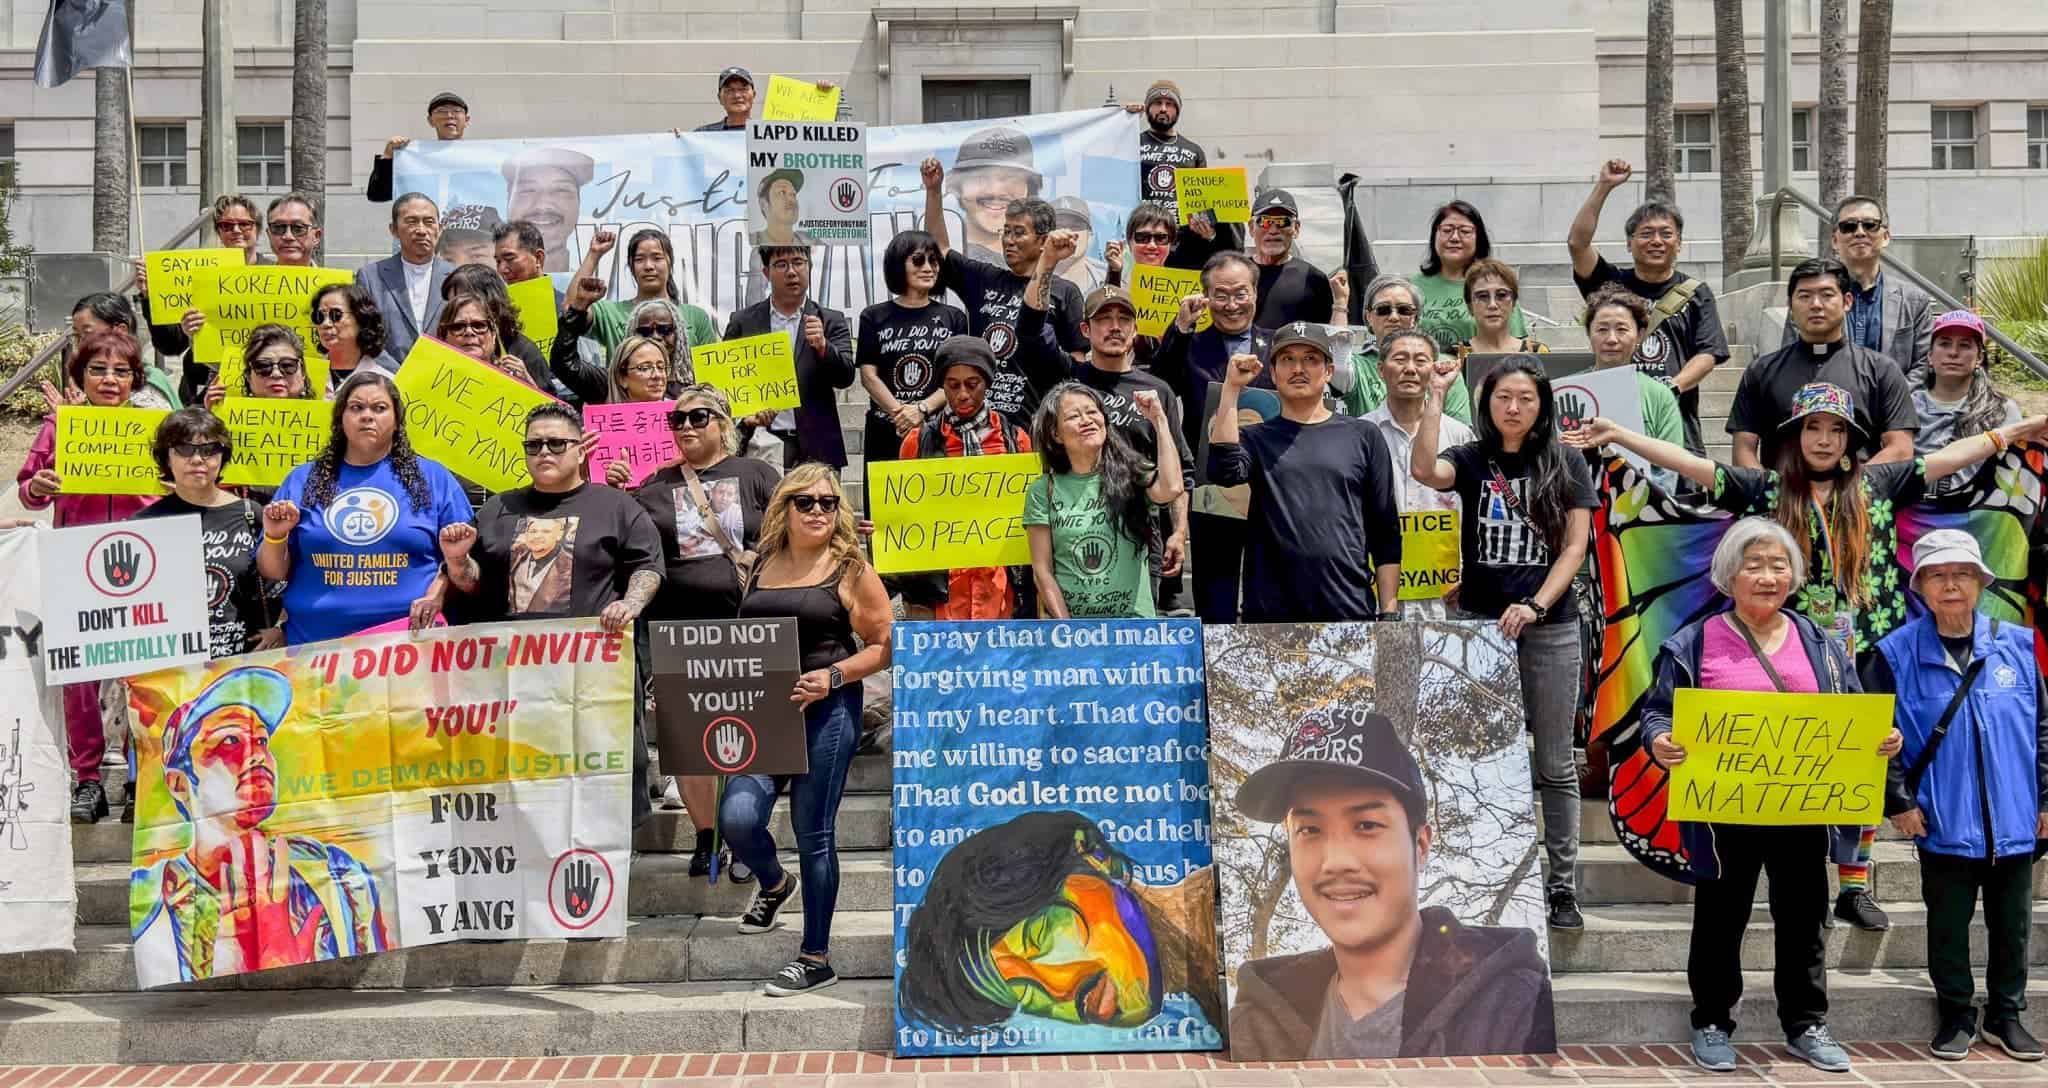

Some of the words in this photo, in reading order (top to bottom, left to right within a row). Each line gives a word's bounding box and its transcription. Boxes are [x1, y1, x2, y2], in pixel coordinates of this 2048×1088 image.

[753, 124, 798, 141] LAPD
[803, 126, 859, 142] KILLED
[750, 152, 778, 167] MY
[784, 153, 864, 169] BROTHER
[1182, 176, 1225, 187] RENDER
[1184, 189, 1203, 198] AID
[1185, 200, 1207, 209] NOT
[160, 257, 192, 273] SAY
[1139, 275, 1202, 294] MENTA
[218, 302, 298, 321] UNITED
[1152, 295, 1182, 306] HEA
[908, 325, 928, 338] DID
[700, 341, 785, 366] JUSTICE
[731, 362, 758, 380] FOR
[431, 362, 484, 410] WE
[724, 384, 752, 405] NG
[754, 377, 797, 402] YANG
[1103, 394, 1127, 409] DID
[229, 407, 321, 429] MENTAL
[230, 431, 320, 451] HEALTH
[404, 391, 466, 448] YONG
[468, 429, 529, 483] YANG
[884, 473, 926, 505] NO
[884, 523, 925, 553] NO
[931, 516, 1026, 553] PEACE
[1400, 515, 1453, 532] TICE
[201, 531, 229, 545] DID
[311, 553, 354, 569] UNITED
[358, 553, 409, 569] FAMILIES
[324, 571, 344, 586] FOR
[346, 571, 398, 586] JUSTICE
[1073, 578, 1110, 586] JYYPC
[78, 607, 129, 633] DON'T
[132, 602, 168, 626] KILL
[683, 625, 722, 646] DID
[730, 624, 781, 645] NOT
[896, 627, 904, 650] I
[912, 632, 980, 656] pray
[987, 627, 1046, 650] that
[1052, 624, 1108, 649] God
[1114, 623, 1196, 647] make
[47, 646, 81, 672] THE
[85, 633, 177, 667] MENTALLY
[182, 632, 208, 655] ILL
[353, 645, 419, 681] DID
[431, 637, 498, 673] NOT
[506, 631, 624, 667] INVITE
[687, 658, 764, 680] INVITE
[892, 664, 1026, 694] forgiving
[1033, 668, 1101, 687] man
[1103, 661, 1173, 685] with
[893, 706, 920, 730] in
[927, 709, 972, 733] my
[978, 702, 1065, 727] heart.
[1069, 701, 1138, 726] That
[1144, 698, 1202, 725] God
[1695, 711, 1862, 752] MENTAL
[893, 749, 938, 769] me
[943, 742, 1045, 771] willing
[1050, 744, 1077, 765] to
[1715, 751, 1835, 782] HEALTH
[286, 773, 338, 797] WE
[352, 757, 487, 790] DEMAND
[497, 750, 625, 776] JUSTICE
[893, 784, 961, 808] That
[968, 781, 1026, 806] God
[1031, 780, 1071, 804] let
[1074, 785, 1120, 804] me
[1125, 781, 1174, 804] not
[1684, 778, 1876, 815] MATTERS
[430, 791, 498, 825] FOR
[895, 827, 924, 848] to
[1098, 818, 1153, 843] God
[418, 845, 517, 880] YONG
[895, 864, 925, 888] to
[421, 899, 516, 936] YANG
[899, 1026, 928, 1048] to
